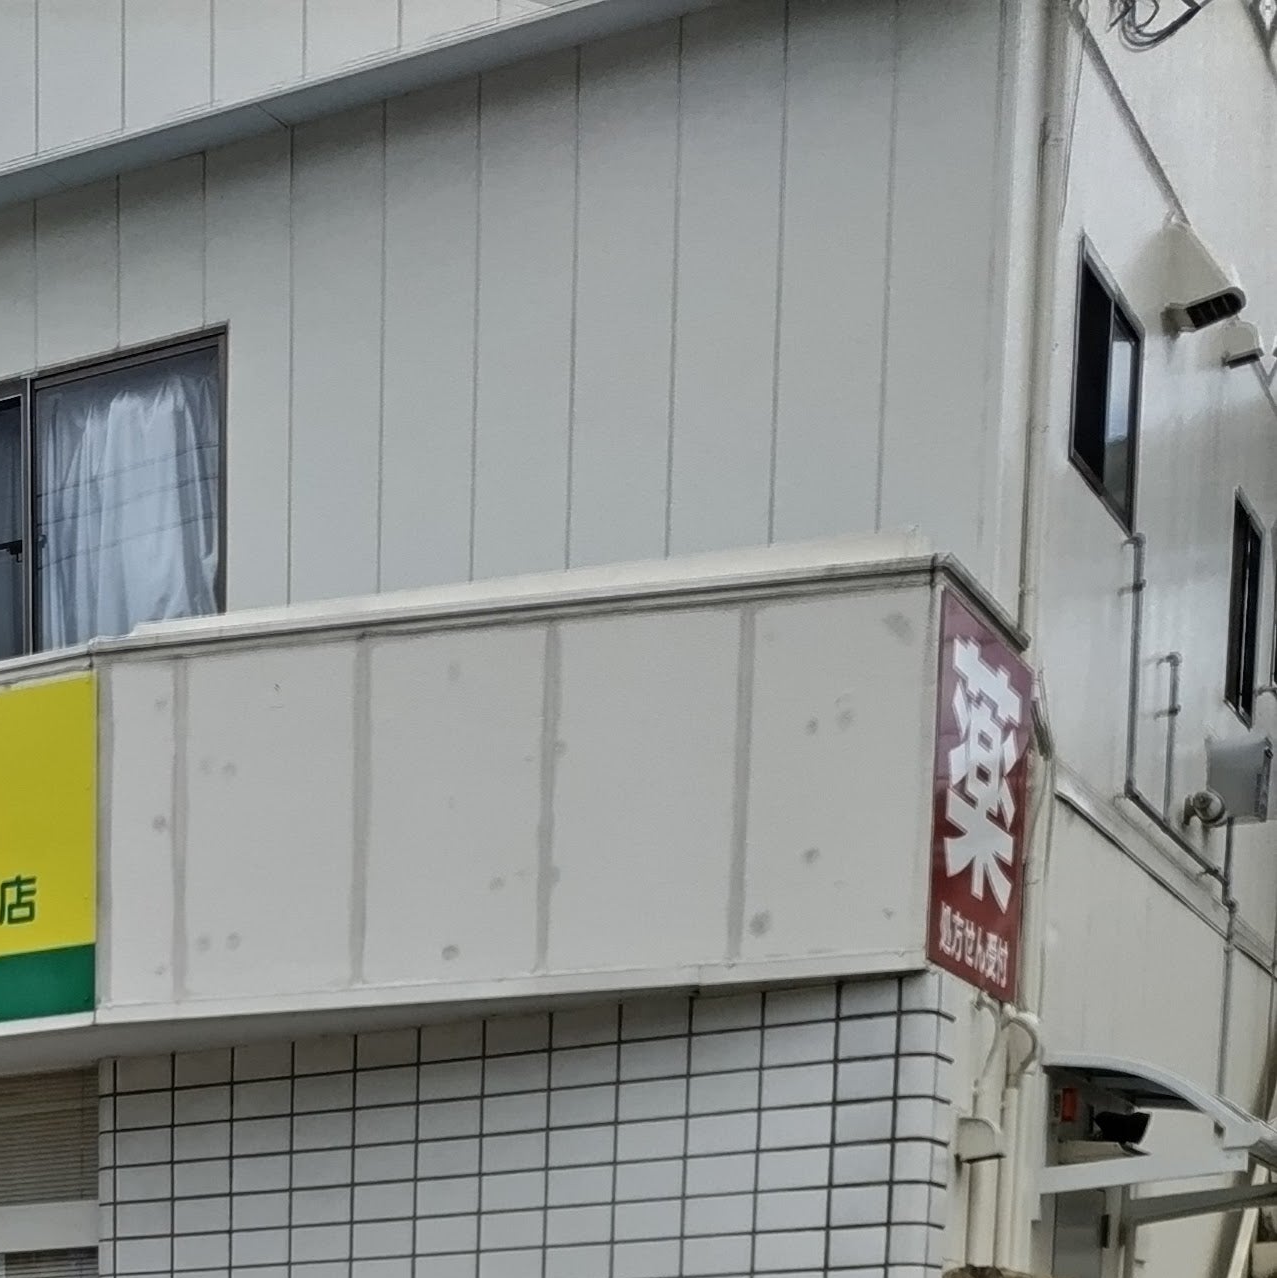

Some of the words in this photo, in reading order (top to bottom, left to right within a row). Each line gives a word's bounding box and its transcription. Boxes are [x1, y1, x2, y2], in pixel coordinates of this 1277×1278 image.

[944, 635, 1022, 915] 薬
[939, 900, 1009, 989] 処方せん受付
